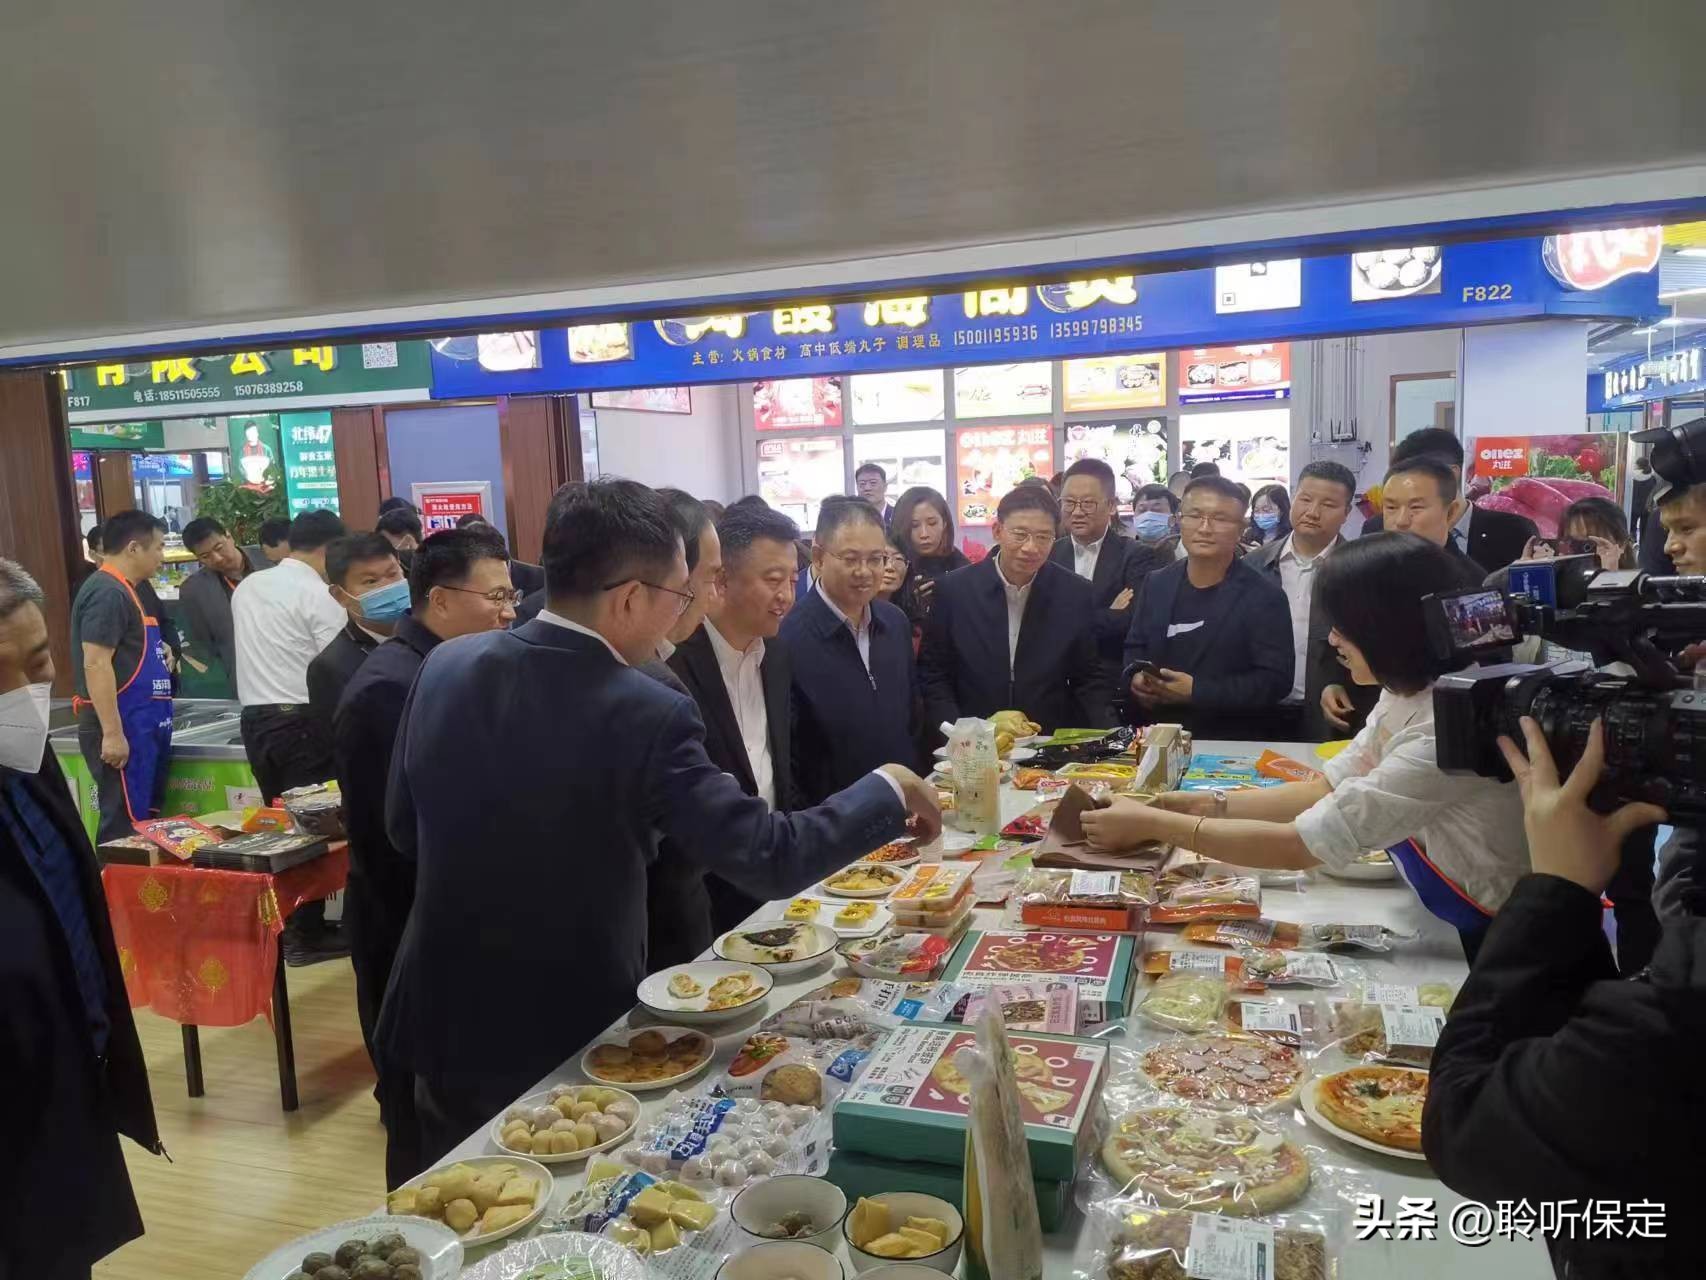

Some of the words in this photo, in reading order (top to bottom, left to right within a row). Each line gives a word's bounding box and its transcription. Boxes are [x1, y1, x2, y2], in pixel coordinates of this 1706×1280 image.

[1462, 284, 1512, 303] F822
[732, 345, 787, 362] 火锅食材
[800, 337, 886, 358] 高中低端丸子
[896, 333, 941, 351] 调理品
[954, 325, 1038, 346] 15001195936
[1050, 315, 1143, 339] 13599798345
[67, 396, 90, 408] F817
[1480, 448, 1524, 460] onez
